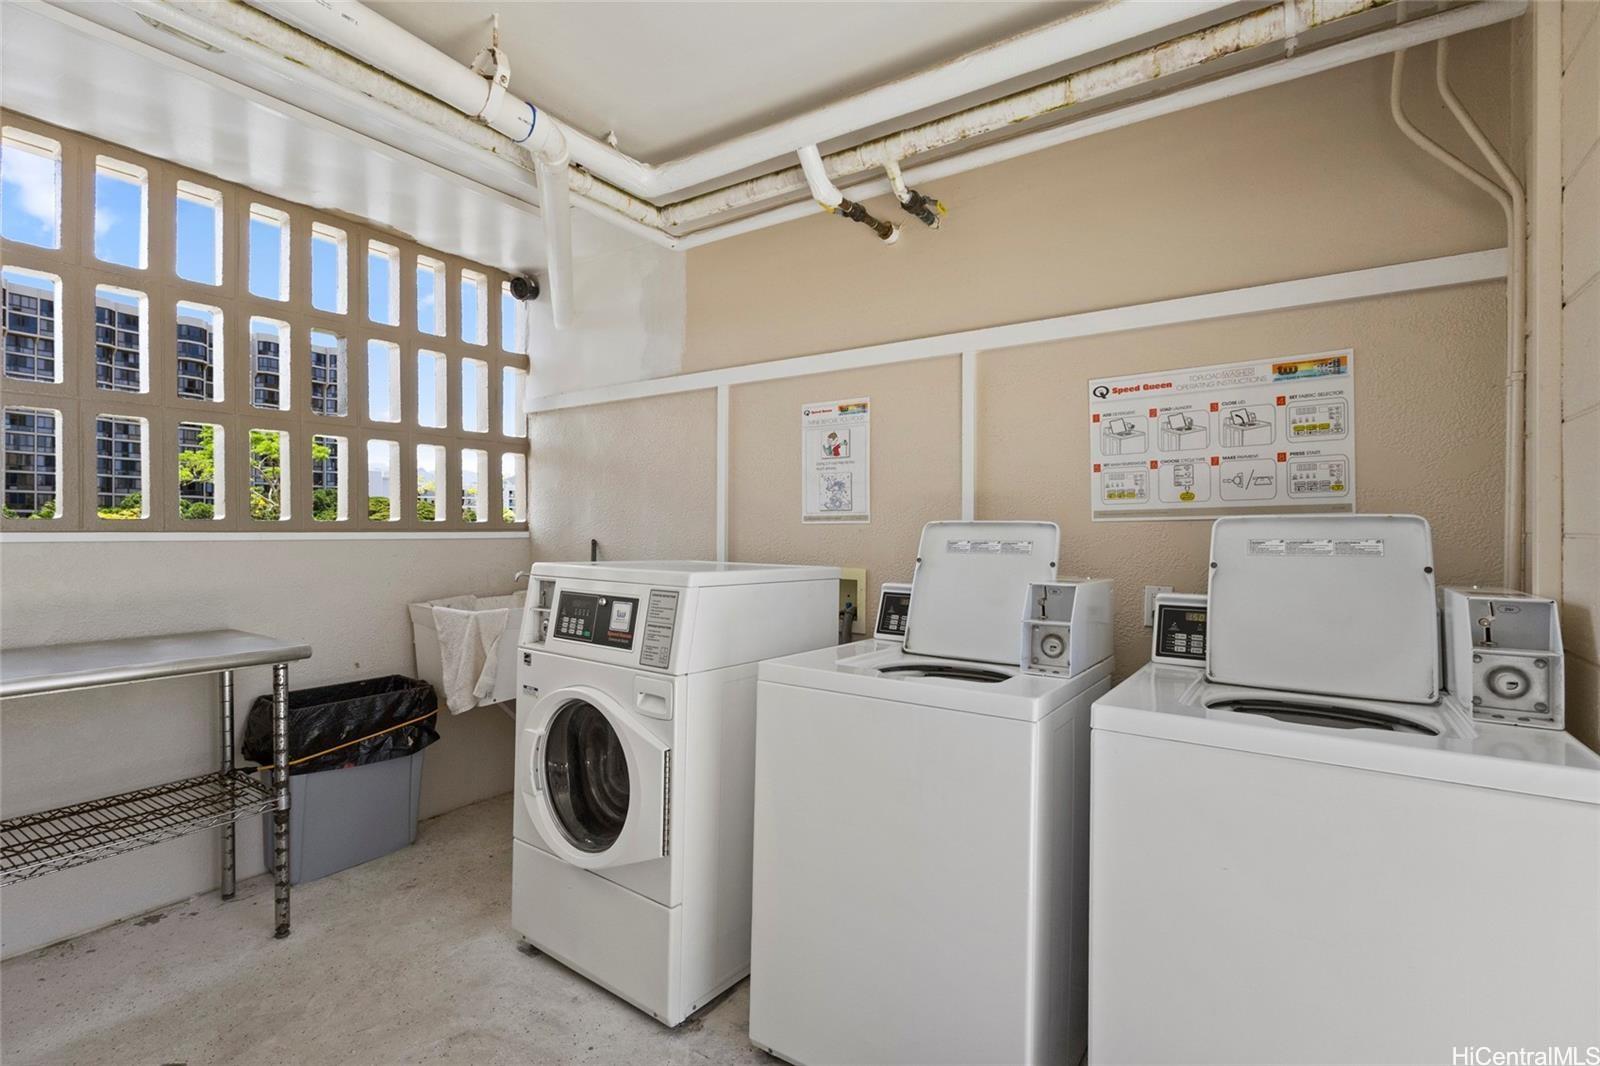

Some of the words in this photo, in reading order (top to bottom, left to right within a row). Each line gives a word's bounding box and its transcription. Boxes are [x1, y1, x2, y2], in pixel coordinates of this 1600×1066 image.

[1222, 367, 1256, 378] WASHER
[1112, 385, 1140, 395] Speed
[1143, 381, 1173, 391] Queen
[1176, 381, 1215, 392] OPERATING
